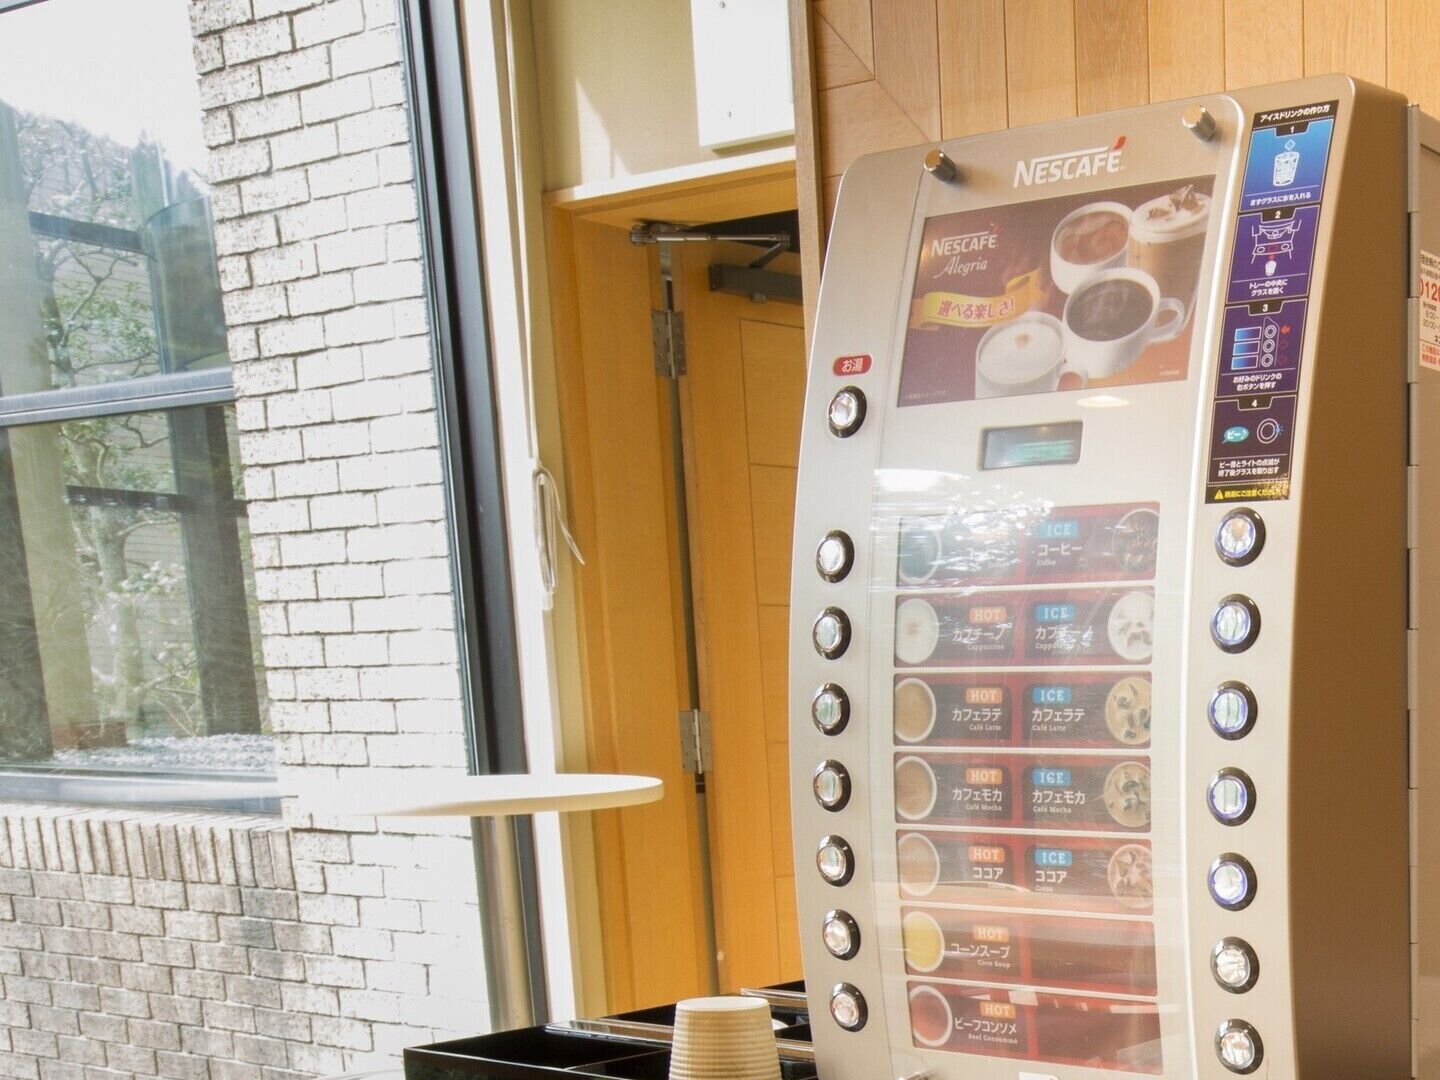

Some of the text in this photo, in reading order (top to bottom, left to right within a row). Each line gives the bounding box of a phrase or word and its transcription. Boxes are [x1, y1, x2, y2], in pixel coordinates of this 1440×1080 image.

[1260, 104, 1331, 123] アイスドリンクの作り方
[1290, 126, 1295, 134] 1
[1013, 136, 1124, 188] NESCAFÉ
[1275, 211, 1281, 219] 2
[931, 223, 998, 257] NESCAFÉ
[933, 257, 988, 279] Alegria
[1262, 304, 1268, 312] 3
[841, 358, 863, 373] お湯
[1232, 372, 1283, 384] お好みのドリンクの
[1252, 399, 1257, 408] 4
[1046, 522, 1071, 536] ICE
[1038, 542, 1083, 556] コーヒー
[974, 609, 1001, 621] HOT
[1044, 608, 1068, 620] ICE
[970, 689, 998, 702] HOT
[1041, 689, 1065, 702] ICE
[952, 708, 1002, 722] カフェラテ
[1032, 707, 1085, 722] カフェラテ
[1049, 724, 1067, 732] Latte
[970, 769, 998, 782] HOT
[952, 788, 1003, 802] カフェモカ
[1032, 789, 1086, 805] カフェモカ
[1049, 806, 1072, 814] Mocha
[973, 849, 999, 861] HOT
[1042, 851, 1066, 865] ICE
[972, 866, 1004, 880] ココア
[1035, 869, 1067, 883] ココア
[977, 928, 1003, 940] HOT
[951, 943, 1011, 959] コーンスープ
[984, 1004, 1010, 1017] HOT
[954, 1017, 1017, 1034] ビーフコンソメ
